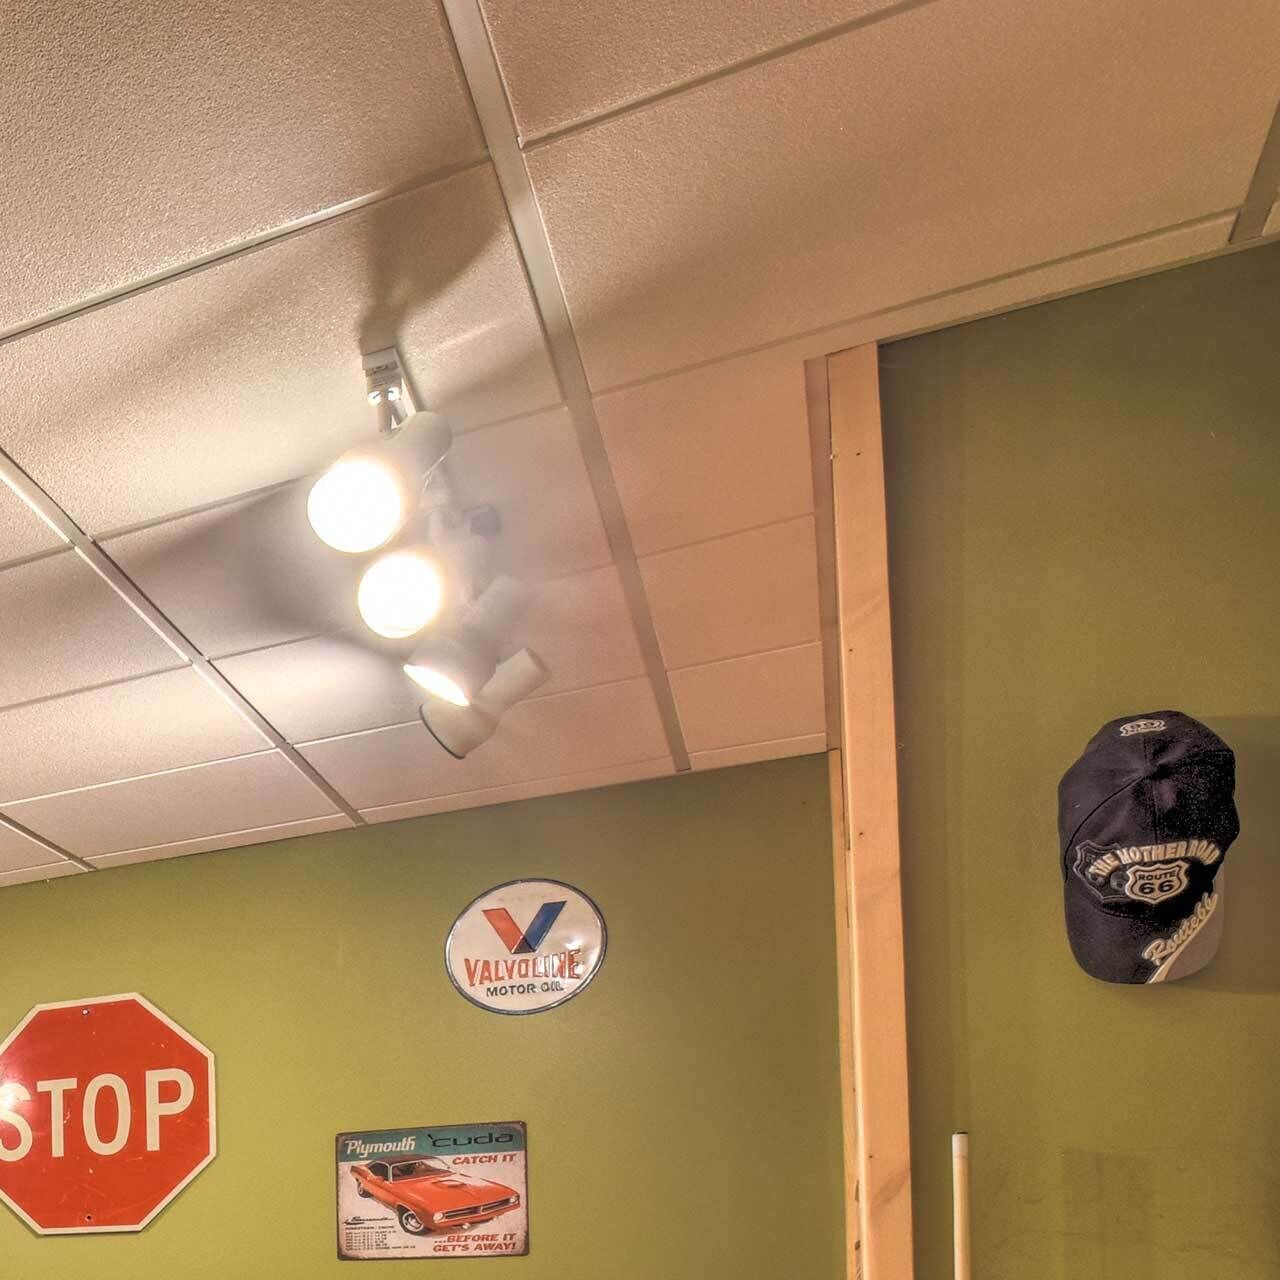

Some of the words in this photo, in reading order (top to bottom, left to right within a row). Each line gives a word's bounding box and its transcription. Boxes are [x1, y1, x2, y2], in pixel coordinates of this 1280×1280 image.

[1089, 853, 1119, 876] THE
[1117, 840, 1187, 864] MOTHER
[1189, 840, 1220, 865] ROAD
[1137, 871, 1177, 880] ROUTE
[1139, 881, 1174, 894] 66
[464, 948, 584, 987] VALVOLINE
[486, 982, 536, 997] MOTOR
[540, 980, 564, 993] OIL
[345, 1136, 416, 1158] Plymouth
[452, 1154, 499, 1165] CATCH
[501, 1154, 516, 1162] IT
[503, 1233, 516, 1242] IT
[432, 1244, 470, 1253] GET'S
[474, 1243, 516, 1252] AWAY!
